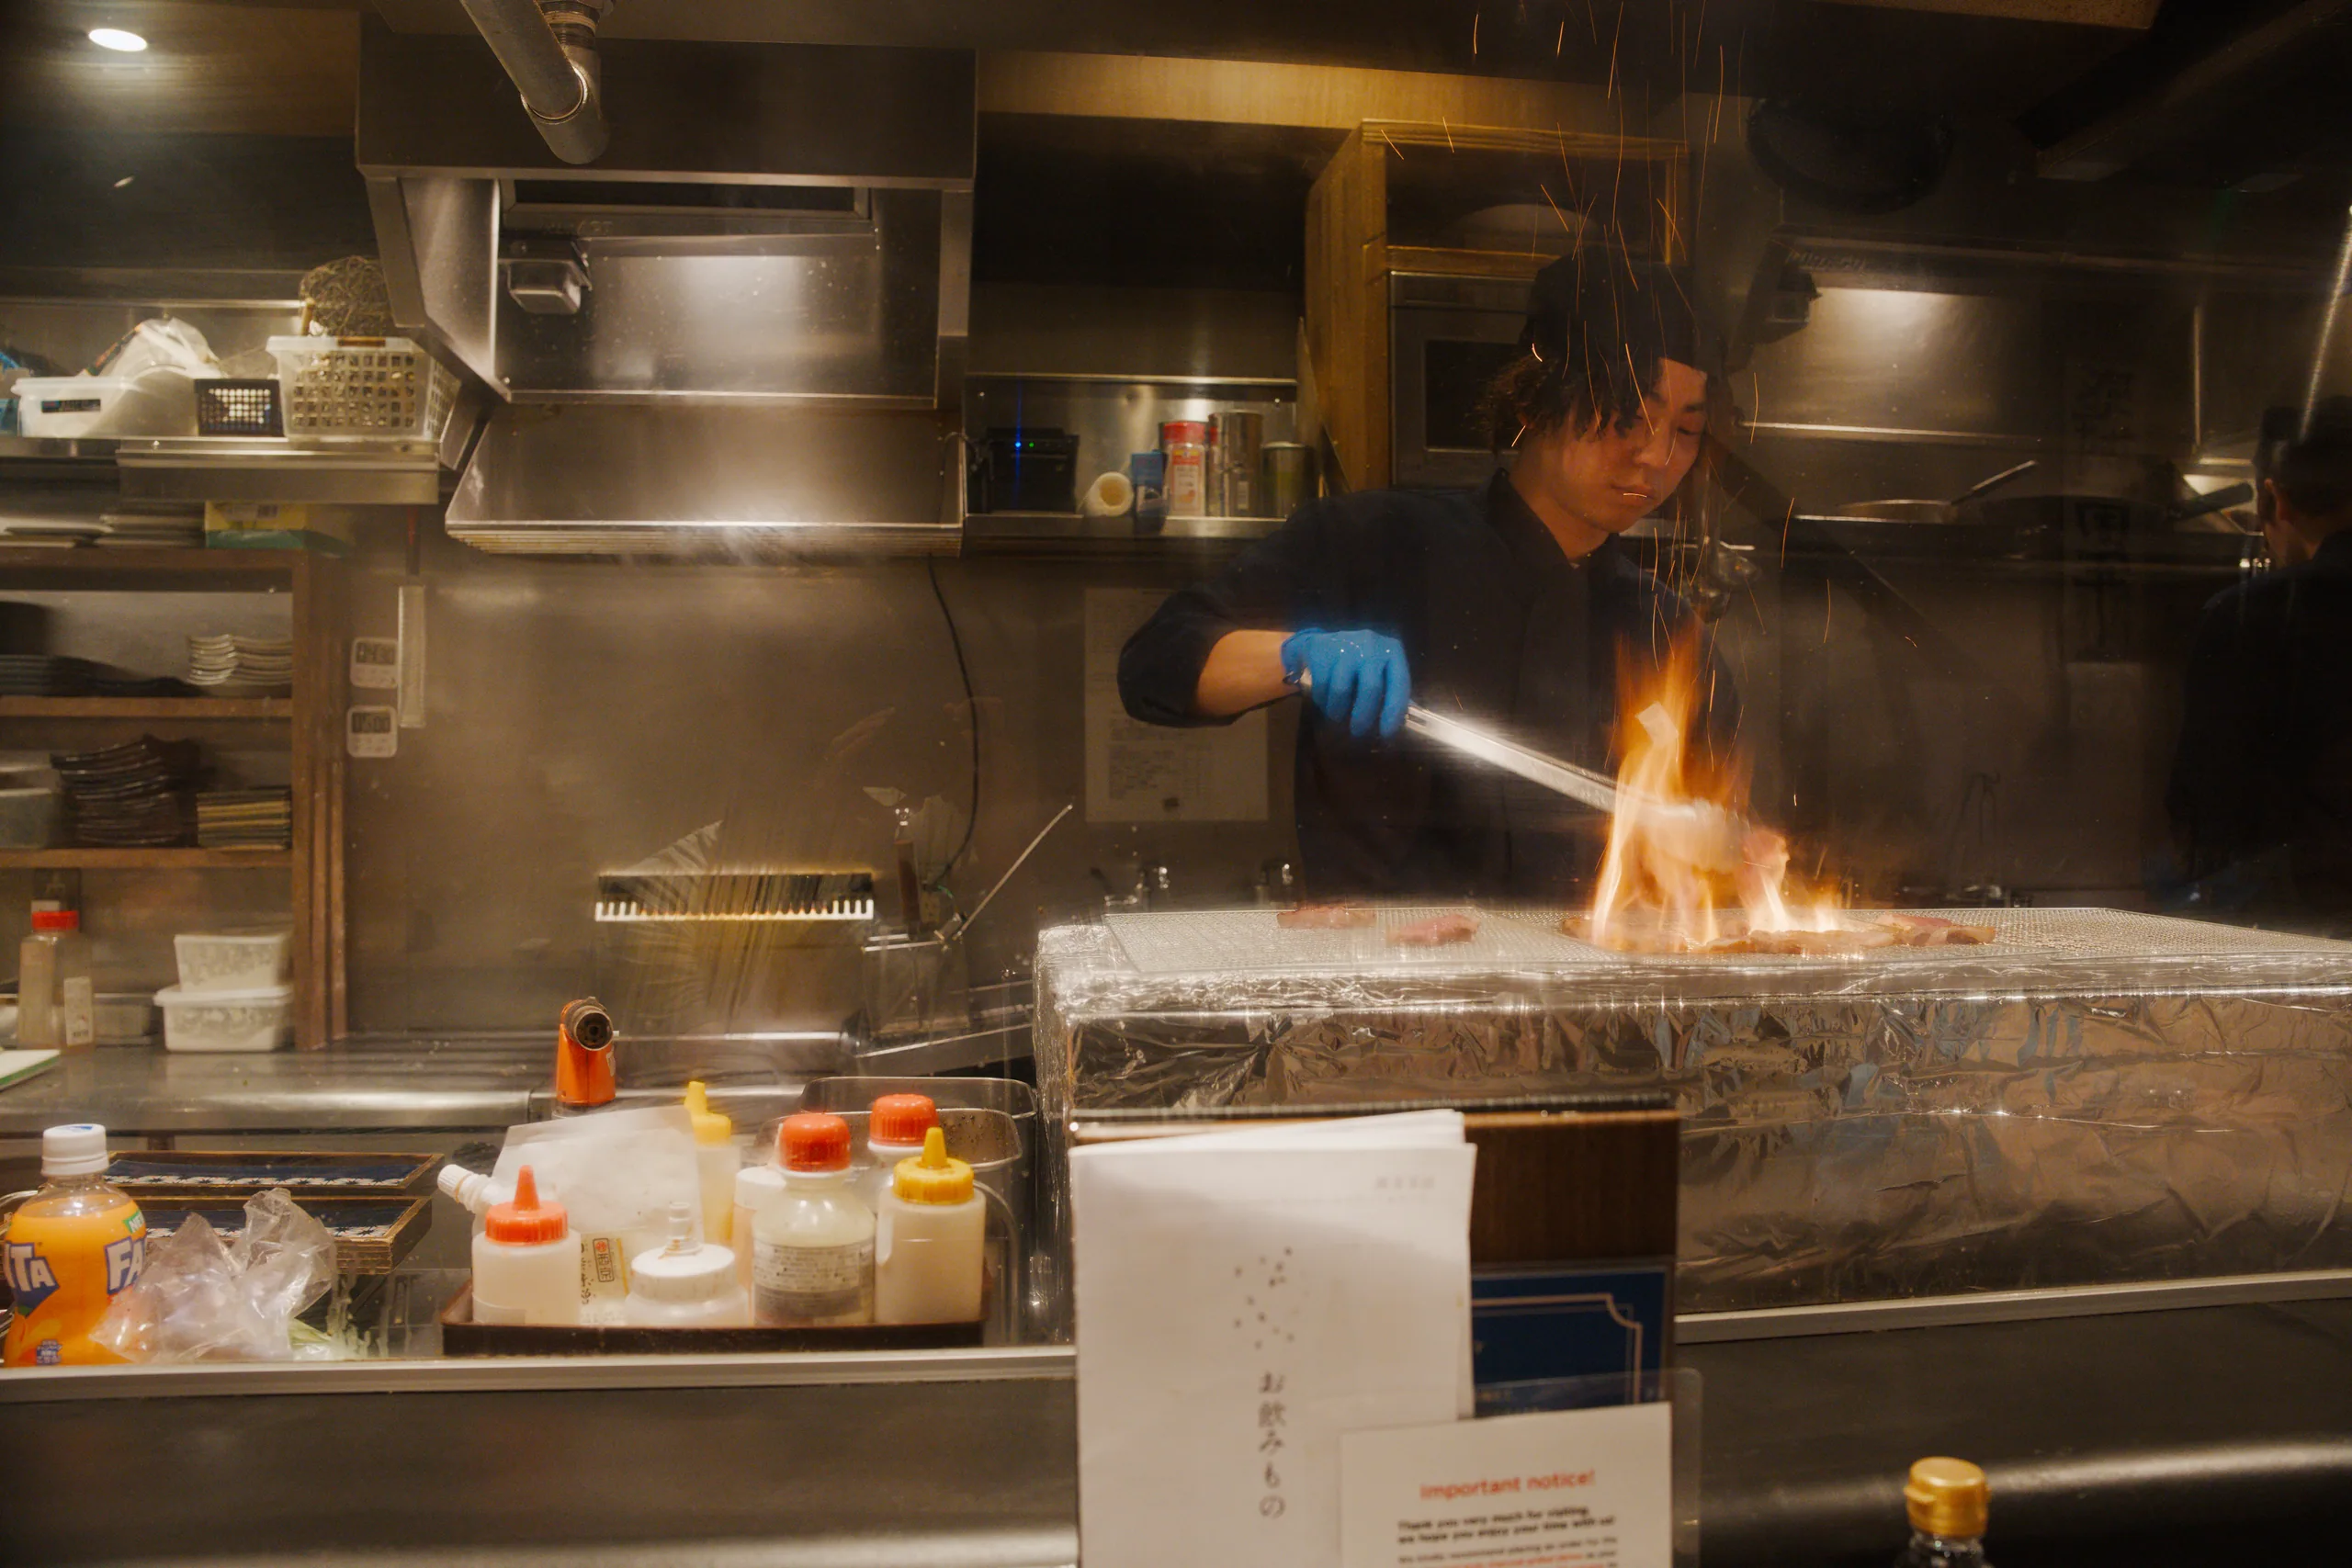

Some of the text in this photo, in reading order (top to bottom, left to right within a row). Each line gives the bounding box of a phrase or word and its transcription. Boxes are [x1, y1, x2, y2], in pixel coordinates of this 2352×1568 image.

[1258, 1371, 1287, 1519] お飲みもの
[1420, 1468, 1596, 1500] Important notice!
